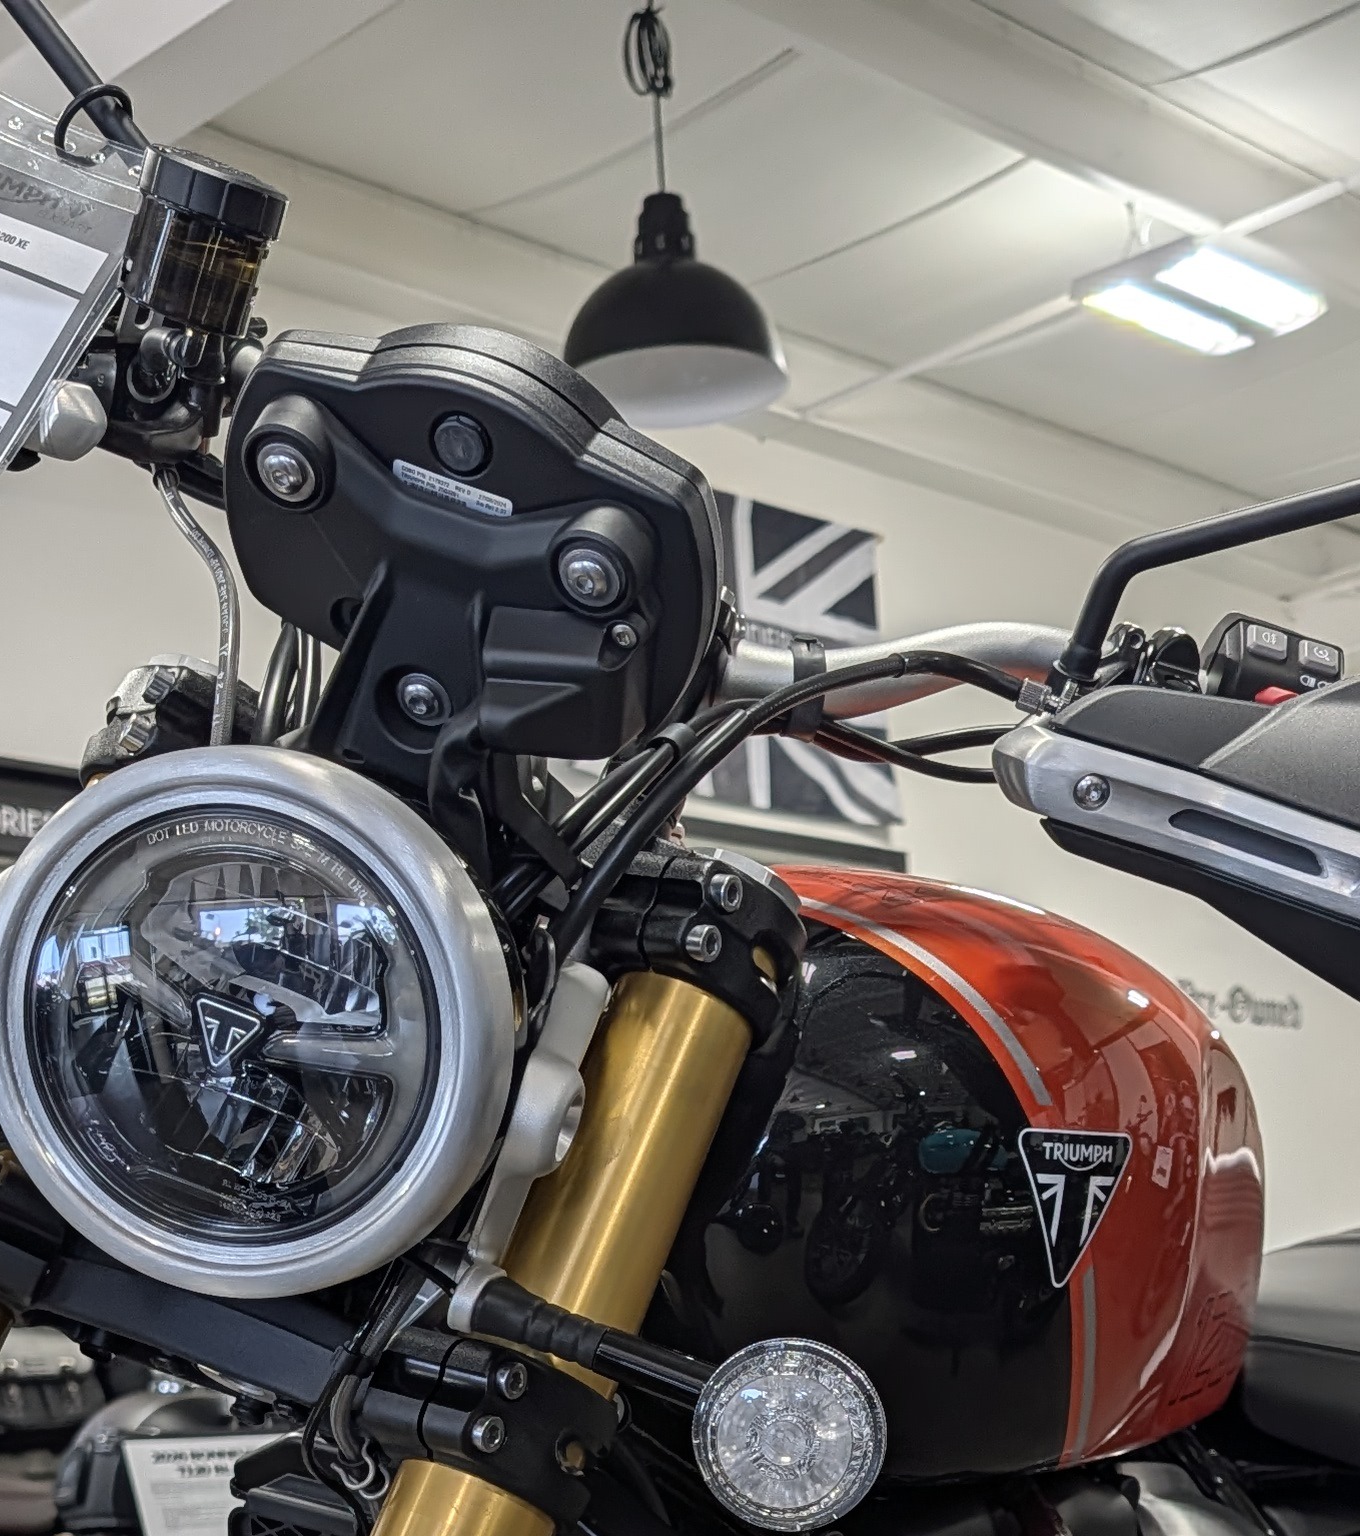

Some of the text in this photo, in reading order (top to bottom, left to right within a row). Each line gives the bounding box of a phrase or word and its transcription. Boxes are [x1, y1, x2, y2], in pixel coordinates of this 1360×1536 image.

[15, 239, 30, 250] XE
[147, 827, 170, 845] DOT
[175, 822, 199, 836] LED
[204, 819, 287, 844] MOTORCYCLE
[1042, 1141, 1114, 1164] TRIUMPH
